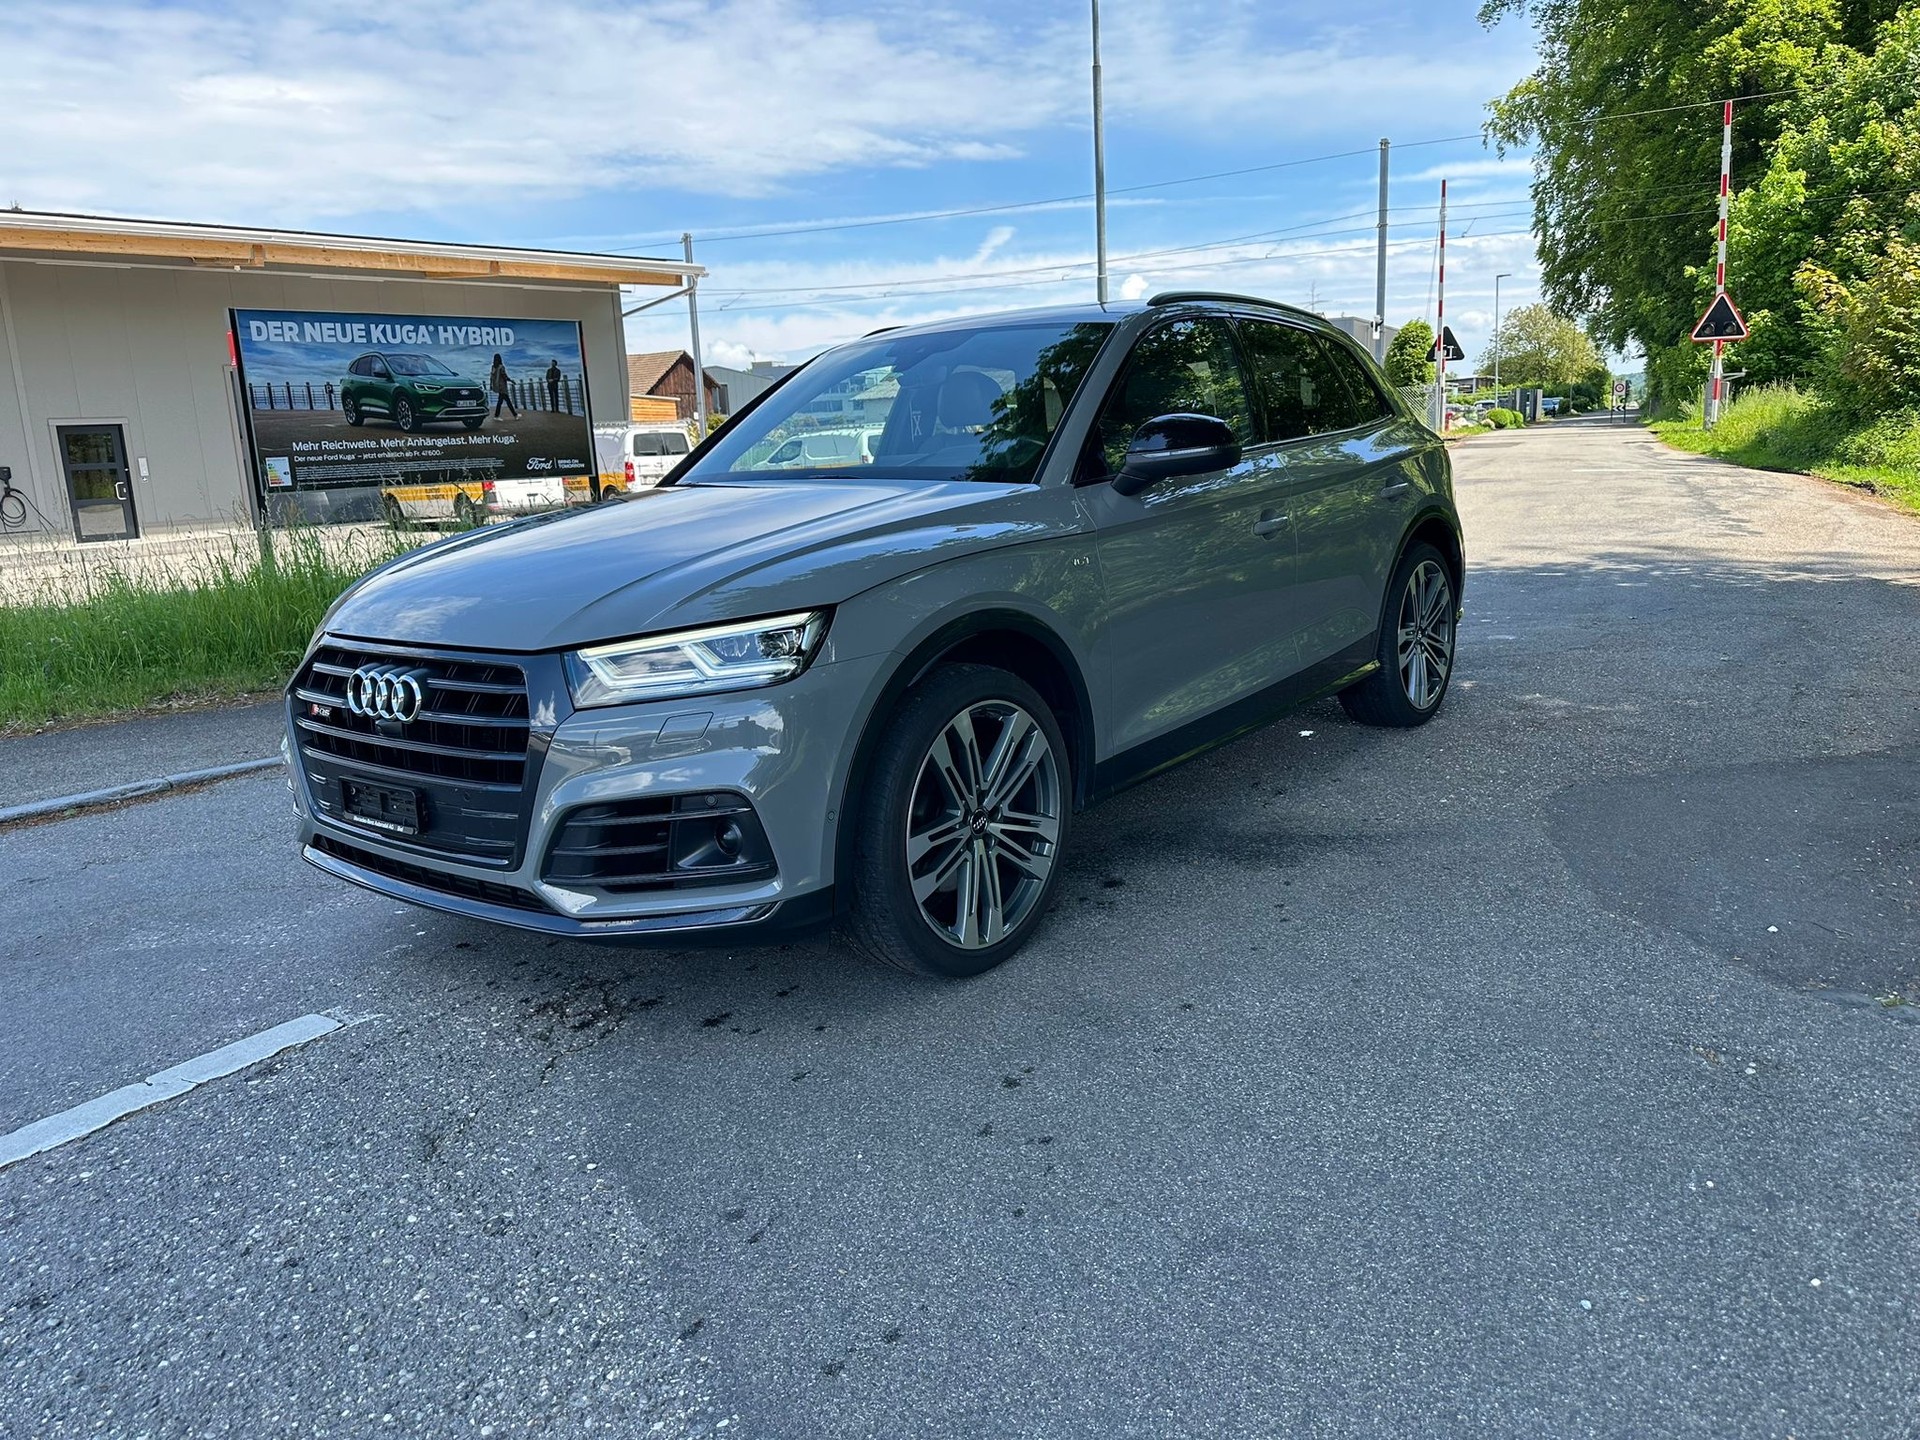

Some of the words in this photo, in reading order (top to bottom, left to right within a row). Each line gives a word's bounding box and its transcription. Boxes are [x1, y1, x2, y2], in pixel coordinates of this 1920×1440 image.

[249, 320, 300, 342] DER
[303, 321, 367, 343] NEUE
[437, 325, 515, 346] HYBRID
[292, 441, 320, 451] Mehr
[321, 439, 379, 450] Reichweite.
[380, 438, 404, 448] Mehr
[407, 436, 468, 447] Anhängelast.
[468, 434, 491, 444] Mehr
[526, 456, 553, 470] Ford
